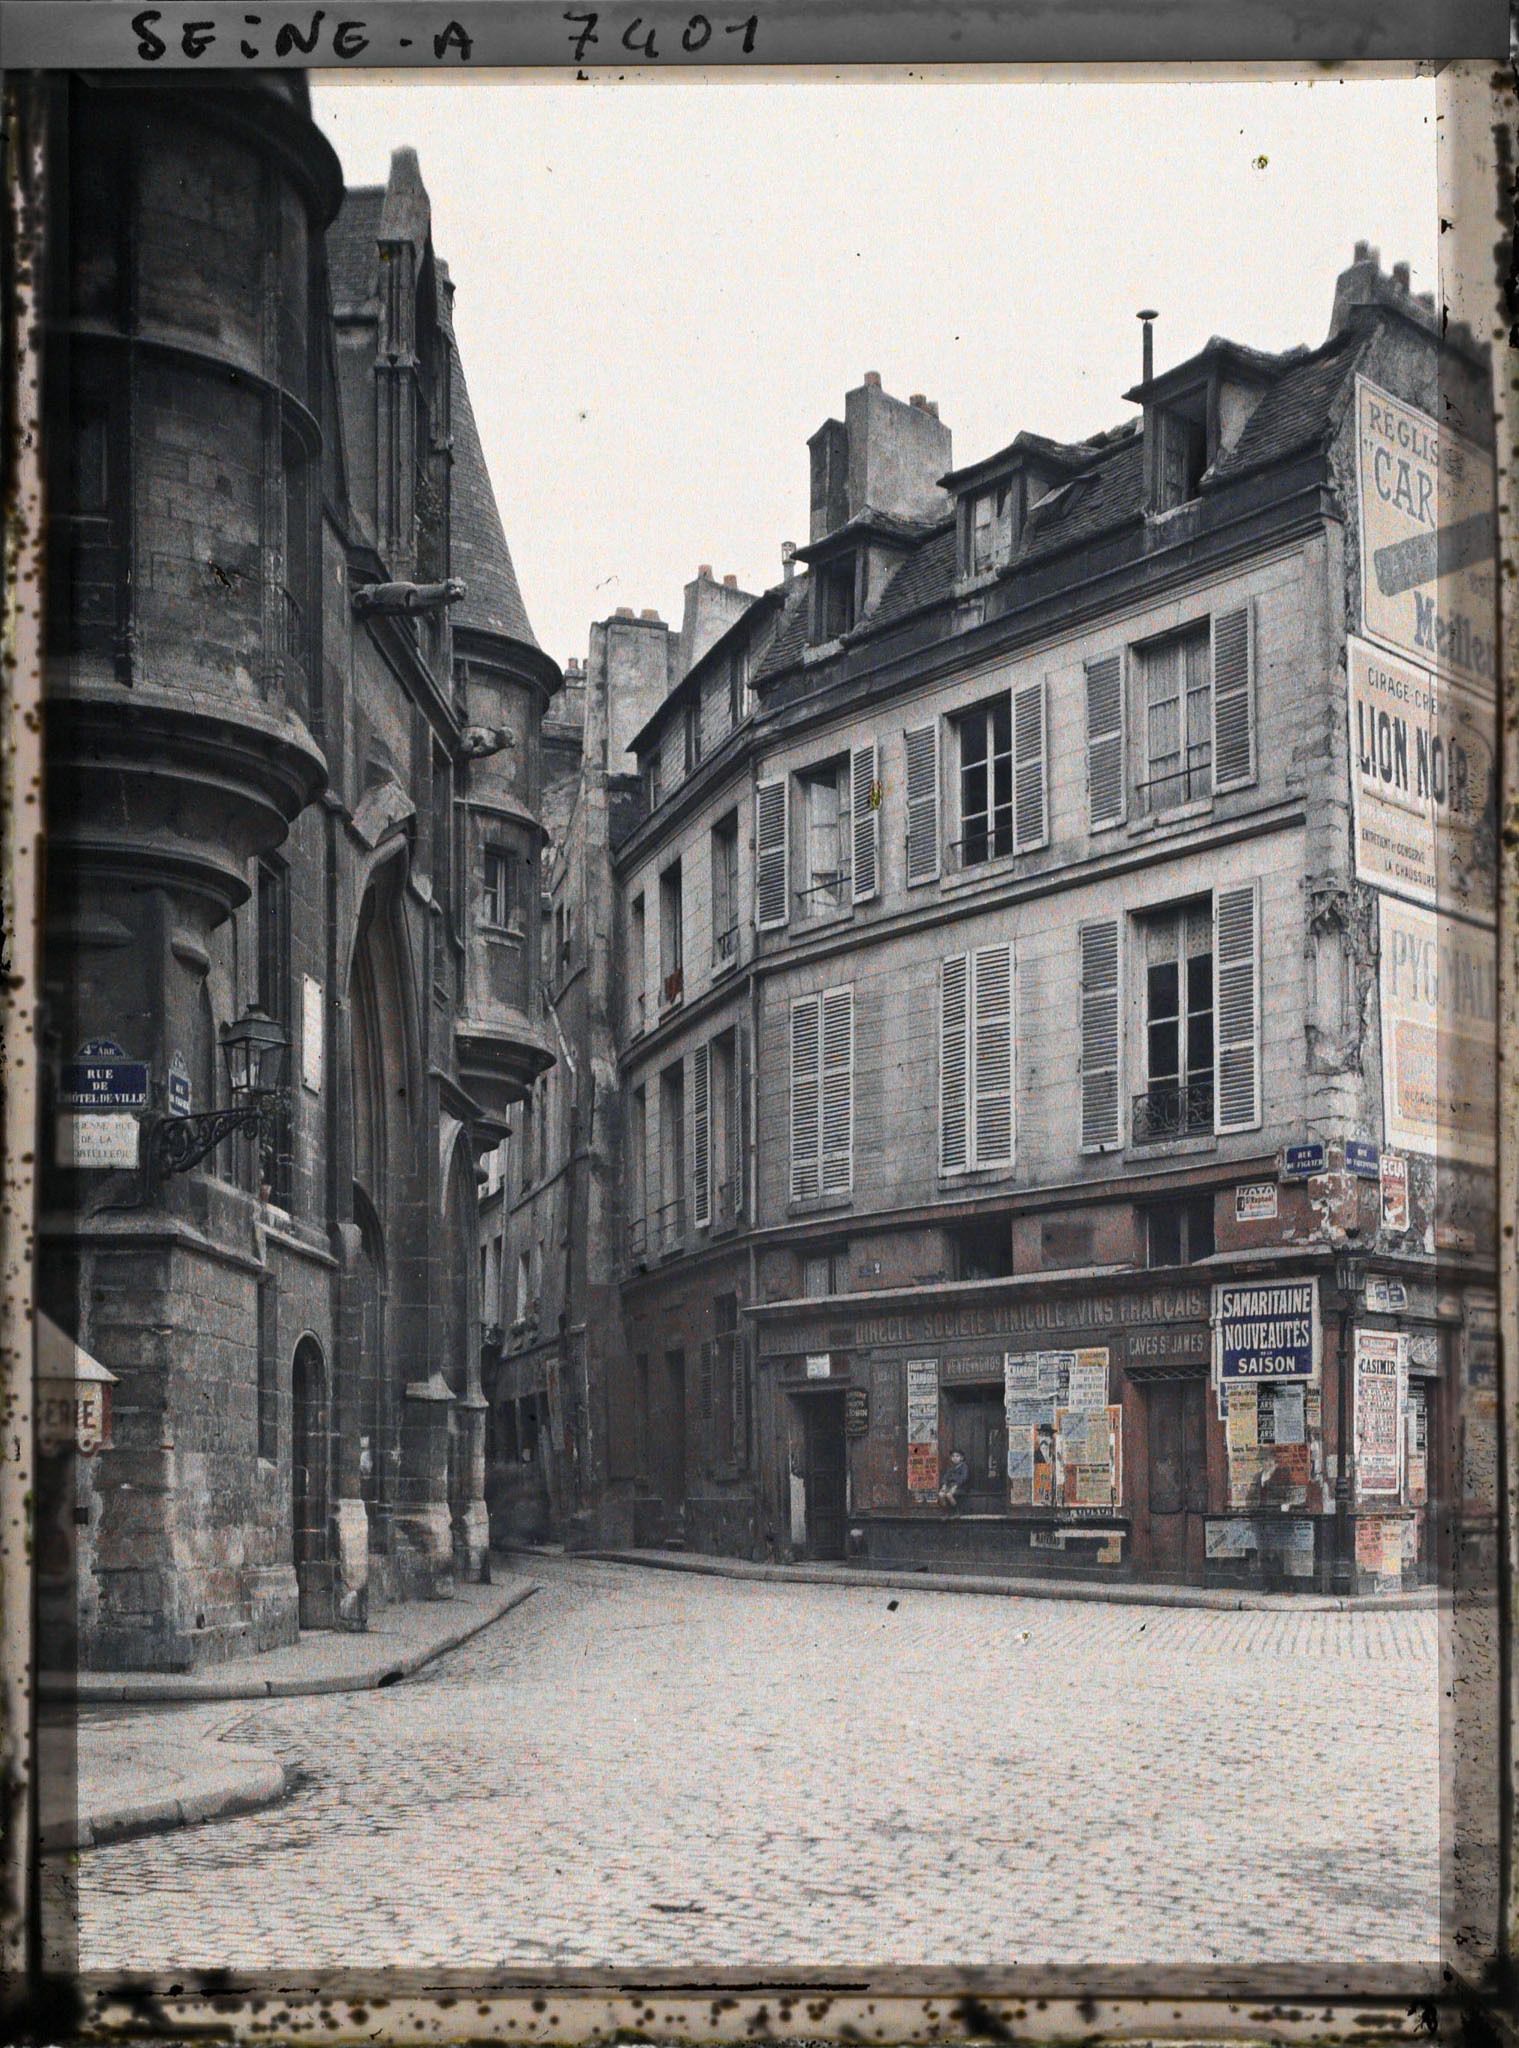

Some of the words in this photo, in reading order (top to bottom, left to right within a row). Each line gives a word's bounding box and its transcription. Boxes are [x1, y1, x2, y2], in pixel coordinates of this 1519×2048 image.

[1357, 699, 1408, 793] LION
[87, 1068, 114, 1080] RUE
[92, 1081, 109, 1091] DE
[100, 1092, 113, 1104] DE
[114, 1092, 146, 1104] VILLE
[1223, 1287, 1311, 1318] SAMARITAINE
[855, 1316, 914, 1345] DIRECTE
[1077, 1297, 1114, 1325] VINS
[1129, 1335, 1158, 1356] CAVES
[1171, 1333, 1204, 1354] JAMES
[1225, 1318, 1310, 1351] NOUVEAUTÉS
[1238, 1355, 1296, 1374] SAISON
[1360, 1358, 1396, 1376] CASIMIR
